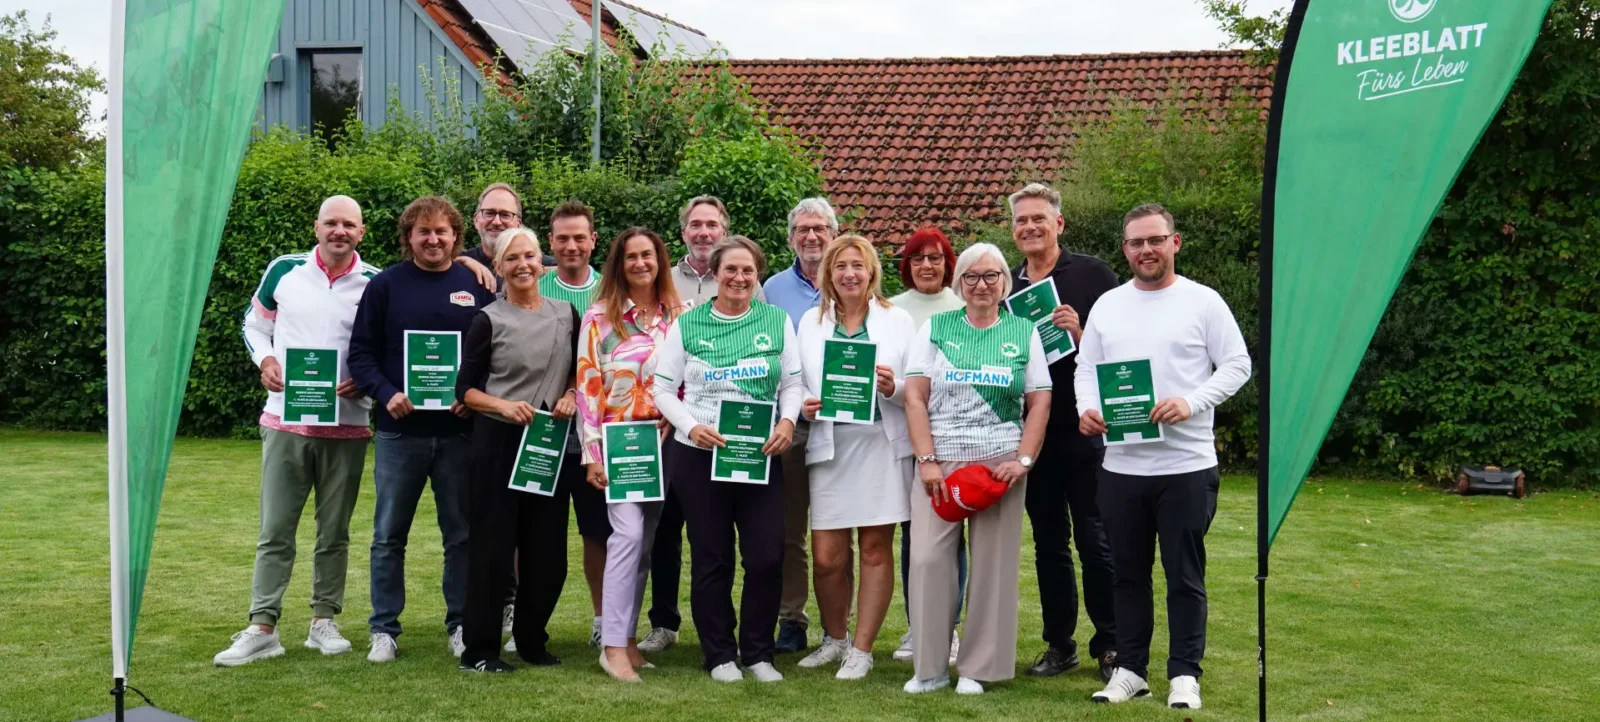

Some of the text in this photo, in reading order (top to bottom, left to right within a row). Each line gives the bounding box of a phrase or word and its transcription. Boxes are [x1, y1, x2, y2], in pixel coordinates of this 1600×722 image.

[1337, 23, 1488, 65] KLEEBLATT
[1357, 54, 1469, 100] Fürs Leben
[704, 365, 766, 381] HOFMANN
[945, 370, 1009, 385] HOFMANN
